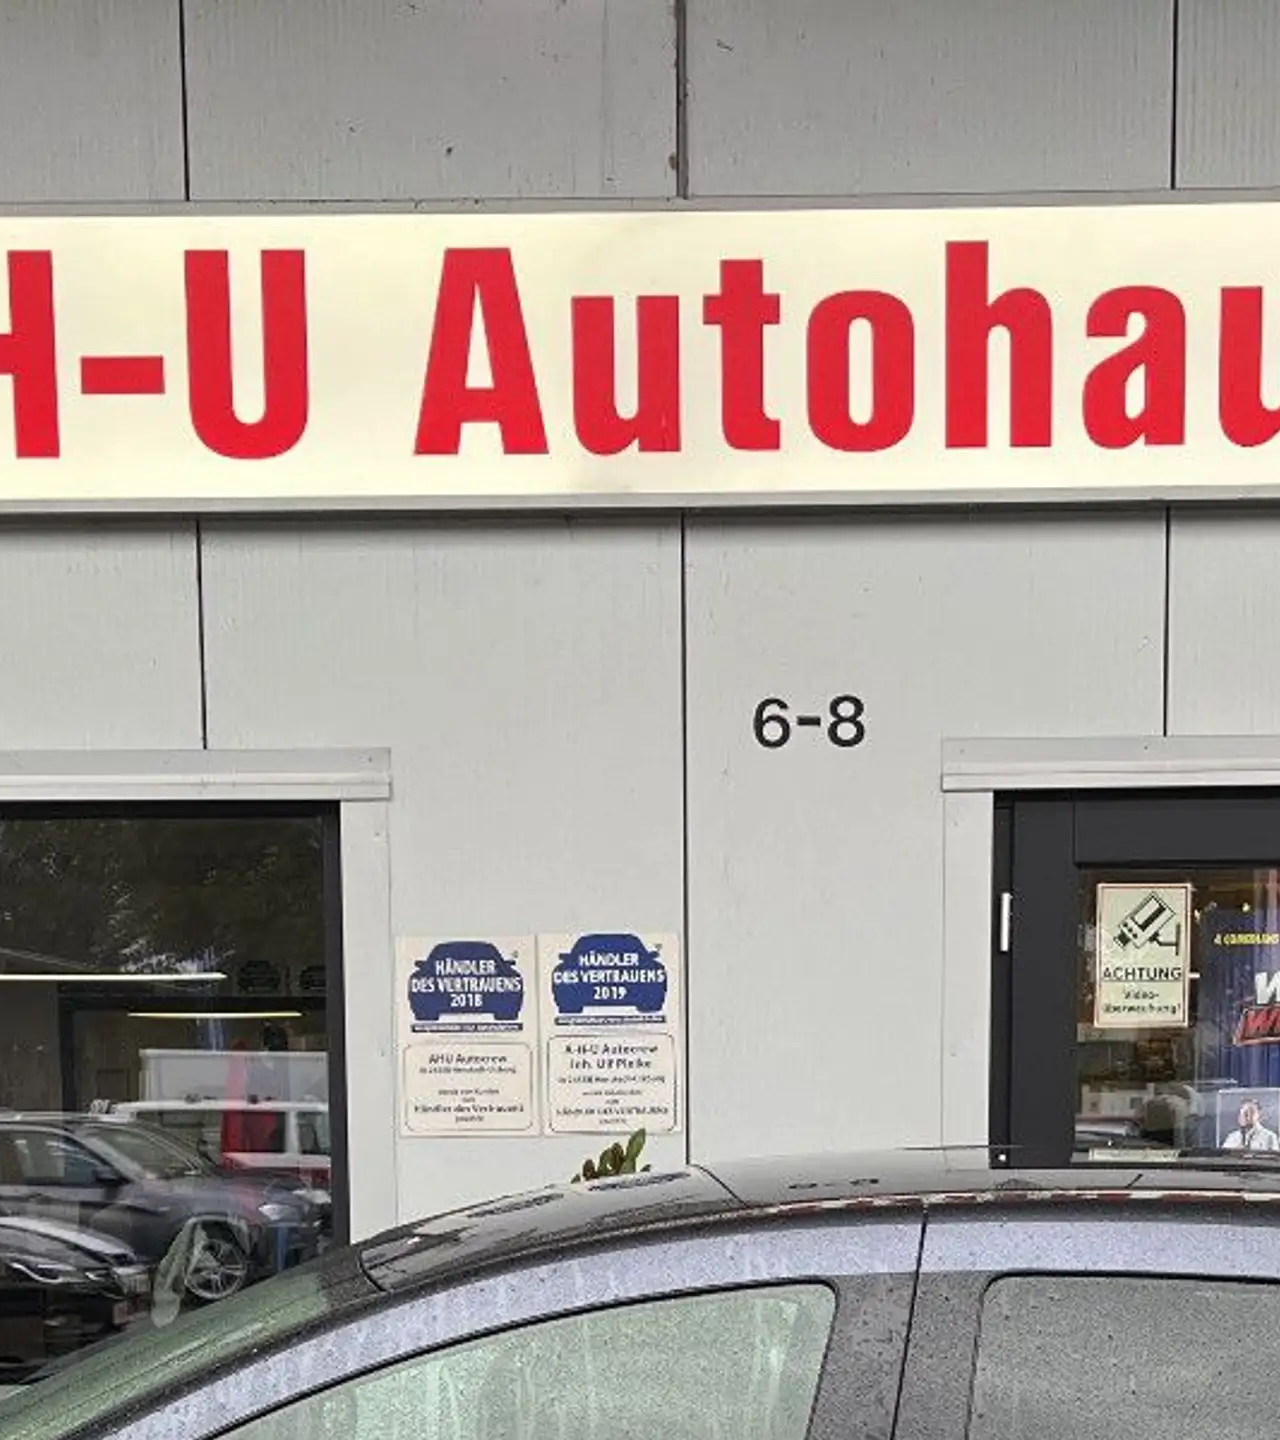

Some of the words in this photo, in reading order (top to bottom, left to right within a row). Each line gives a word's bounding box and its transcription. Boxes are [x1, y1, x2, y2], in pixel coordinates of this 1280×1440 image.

[753, 694, 865, 748] 6-8
[553, 970, 578, 983] DES
[580, 969, 665, 983] VERTRAUENS
[1103, 967, 1182, 980] ACHTUNG
[411, 977, 435, 992] DES
[437, 976, 521, 992] VERTRAUENS
[593, 986, 628, 1000] 2019
[450, 994, 483, 1007] 2018
